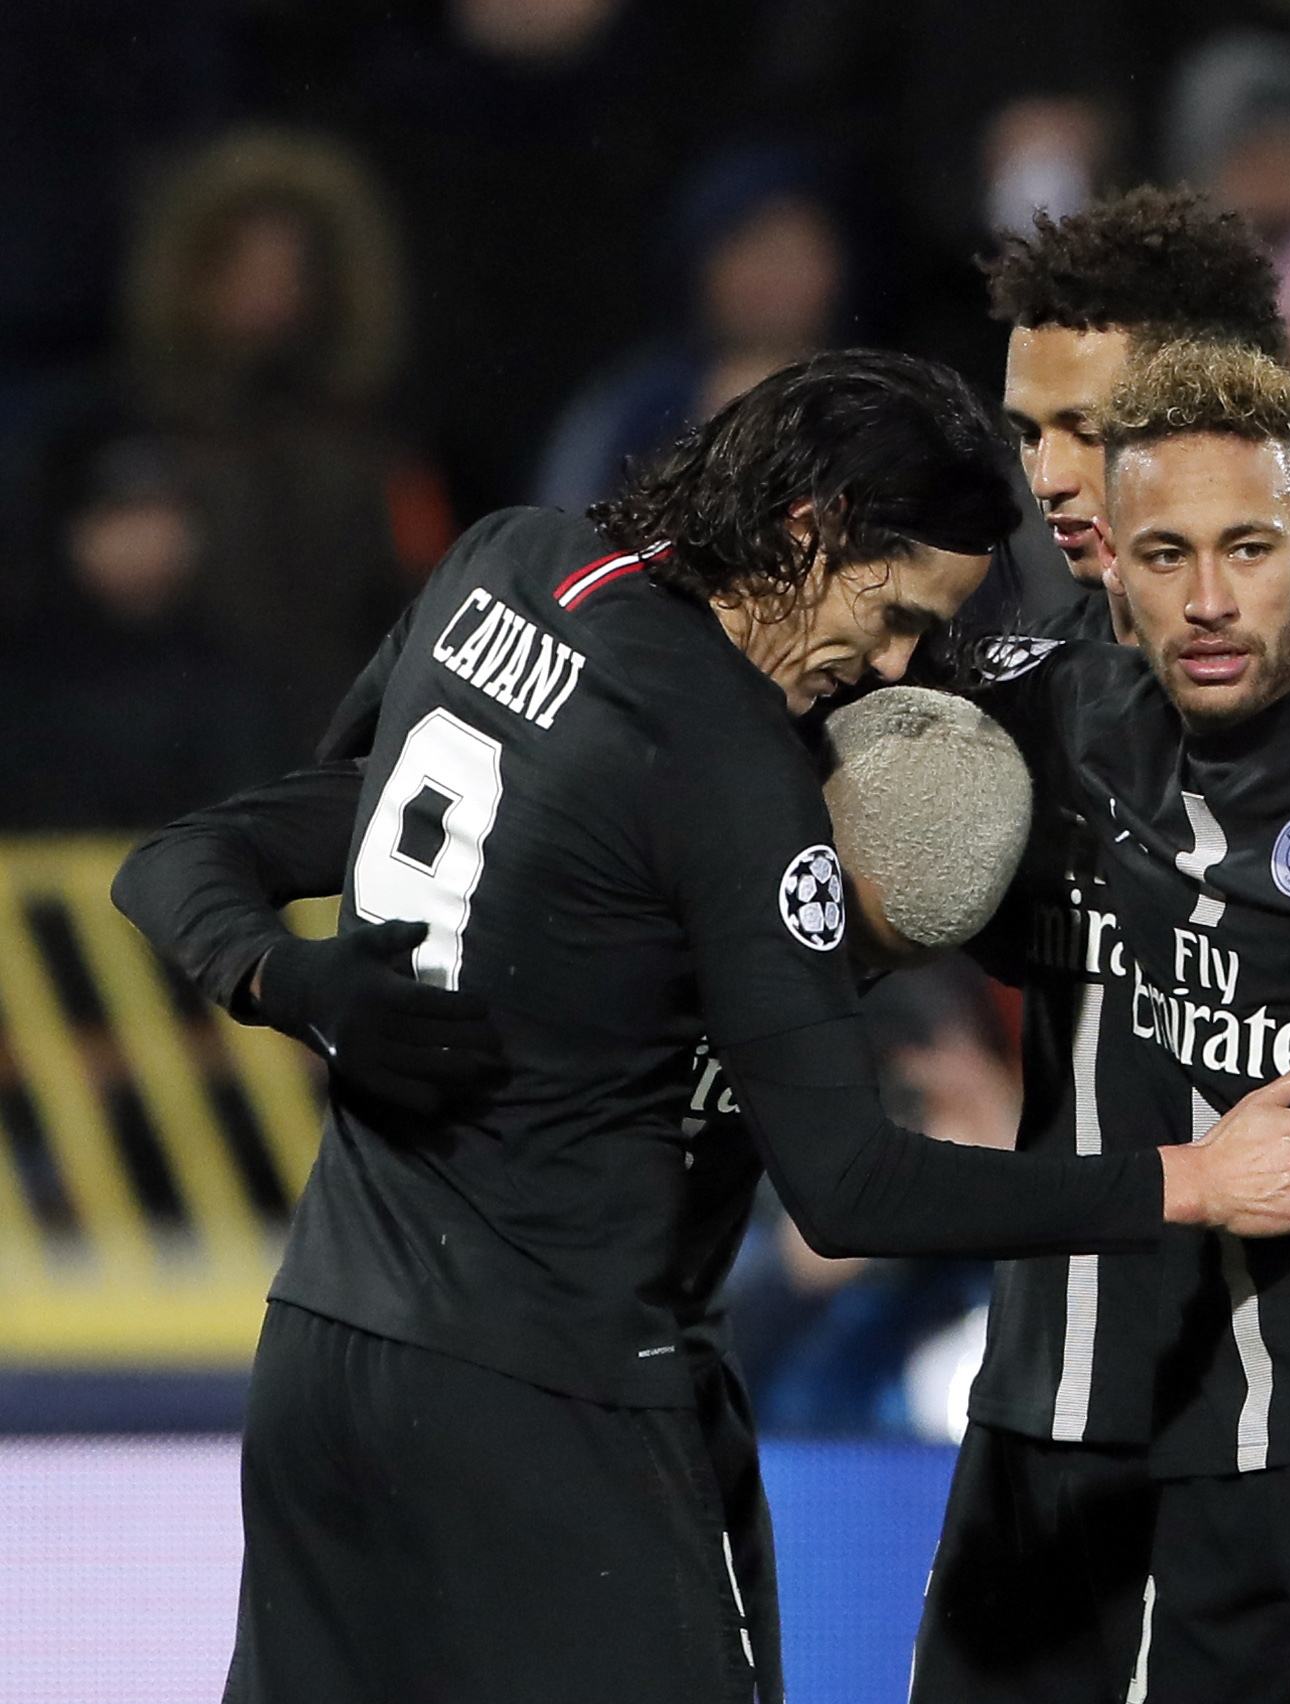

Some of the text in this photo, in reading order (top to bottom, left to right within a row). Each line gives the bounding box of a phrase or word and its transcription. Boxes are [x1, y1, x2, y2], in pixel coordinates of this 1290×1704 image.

[431, 586, 587, 731] CAVANI
[354, 706, 504, 992] 9
[1173, 927, 1240, 1005] Fly
